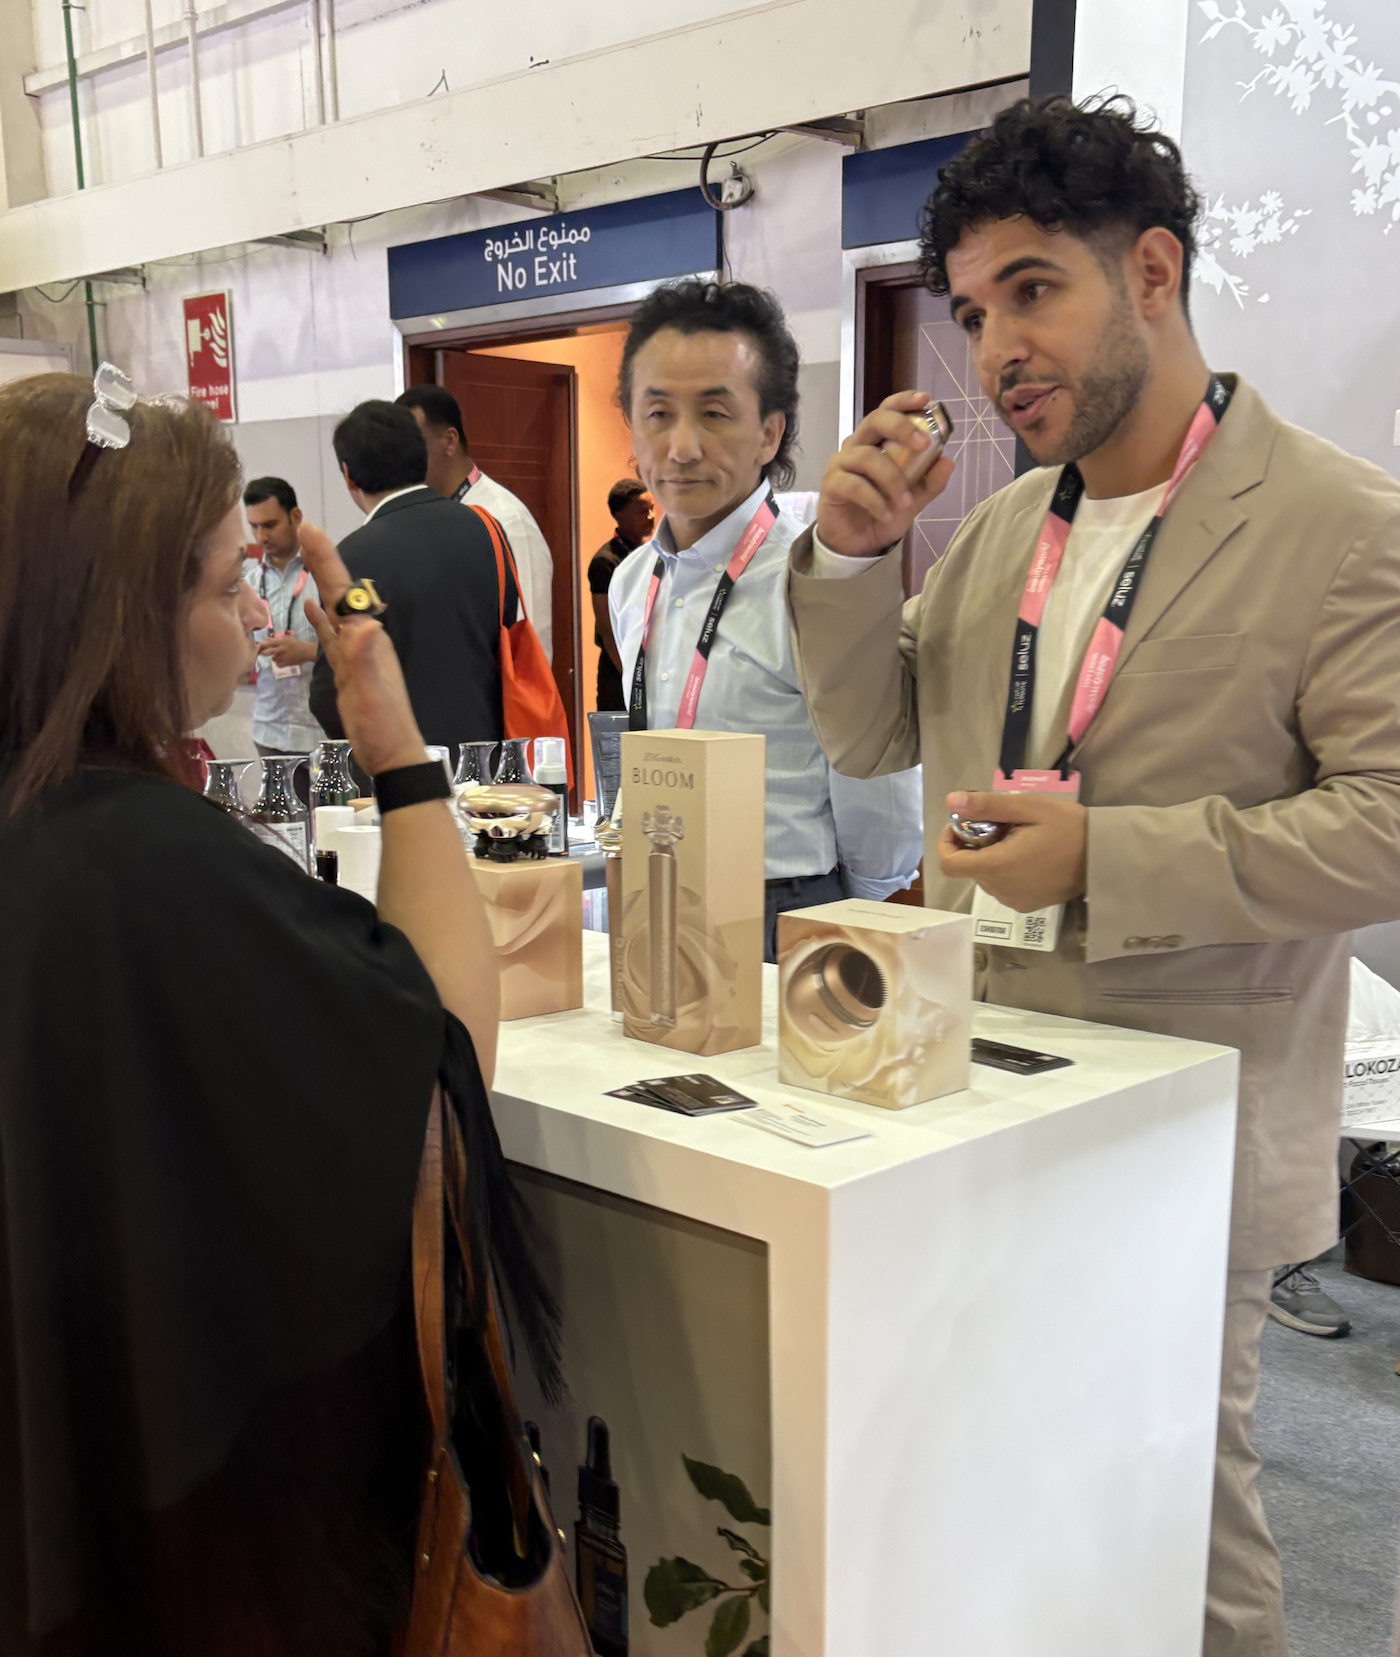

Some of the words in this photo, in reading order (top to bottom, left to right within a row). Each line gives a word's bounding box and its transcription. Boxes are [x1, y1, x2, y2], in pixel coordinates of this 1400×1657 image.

[484, 229, 534, 262] الخروج
[537, 222, 591, 252] ممنوع
[497, 261, 527, 292] No
[534, 252, 577, 286] Exit
[631, 767, 695, 790] BLOOM
[1344, 1058, 1400, 1079] LOKOZ
